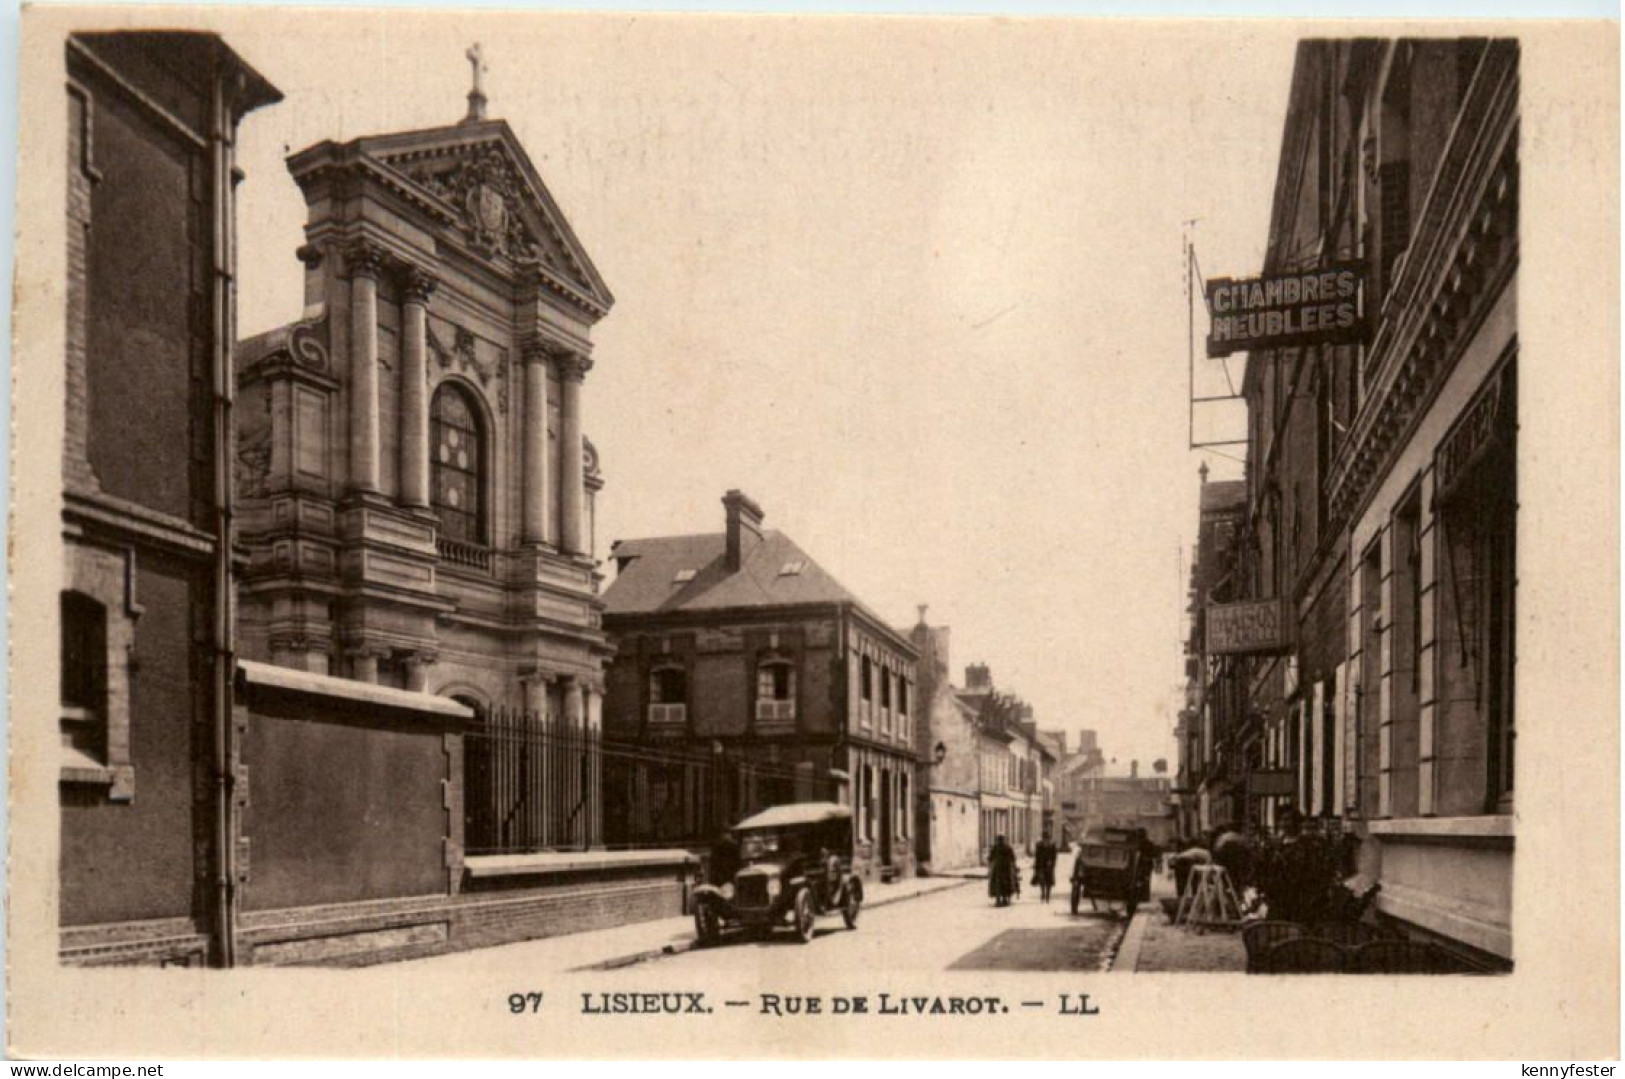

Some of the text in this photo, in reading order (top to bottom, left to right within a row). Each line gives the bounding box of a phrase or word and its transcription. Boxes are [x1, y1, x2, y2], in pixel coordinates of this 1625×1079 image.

[1214, 270, 1355, 312] CHAMBRES
[1213, 302, 1355, 341] MEUBLEES
[508, 993, 542, 1014] 97
[581, 993, 713, 1014] LISIEUX.
[760, 993, 822, 1017] RUE
[832, 996, 869, 1014] DE
[878, 993, 1009, 1014] LIVAROT.
[1059, 994, 1100, 1015] LL
